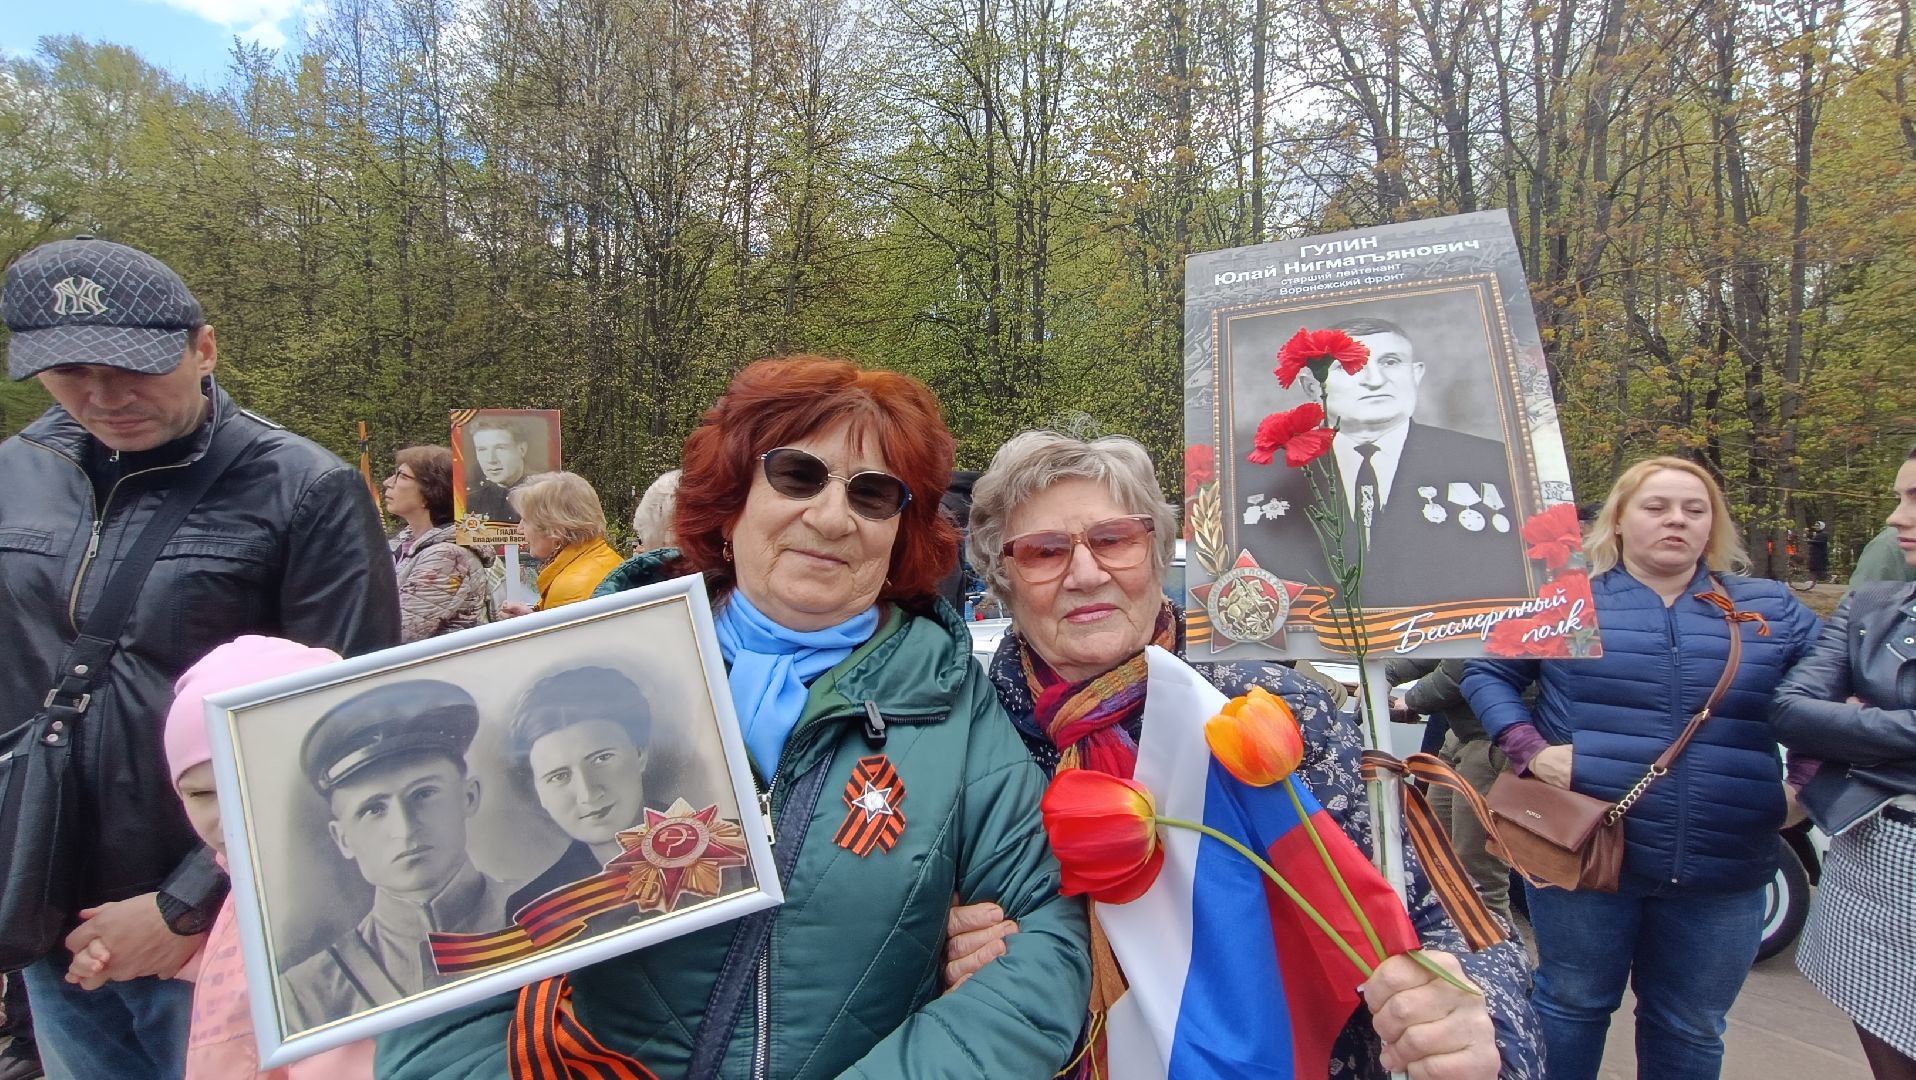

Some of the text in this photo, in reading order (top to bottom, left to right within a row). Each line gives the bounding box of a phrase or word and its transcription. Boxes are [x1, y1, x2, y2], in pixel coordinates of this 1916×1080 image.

[1214, 239, 1480, 286] Юлай Нигматъянович
[1300, 236, 1378, 258] ГУЛИН
[1279, 272, 1405, 296] Воронежский фронт
[1281, 263, 1402, 286] старший лейтенант
[1390, 588, 1567, 654] Бессмертный
[1521, 599, 1585, 643] полк
